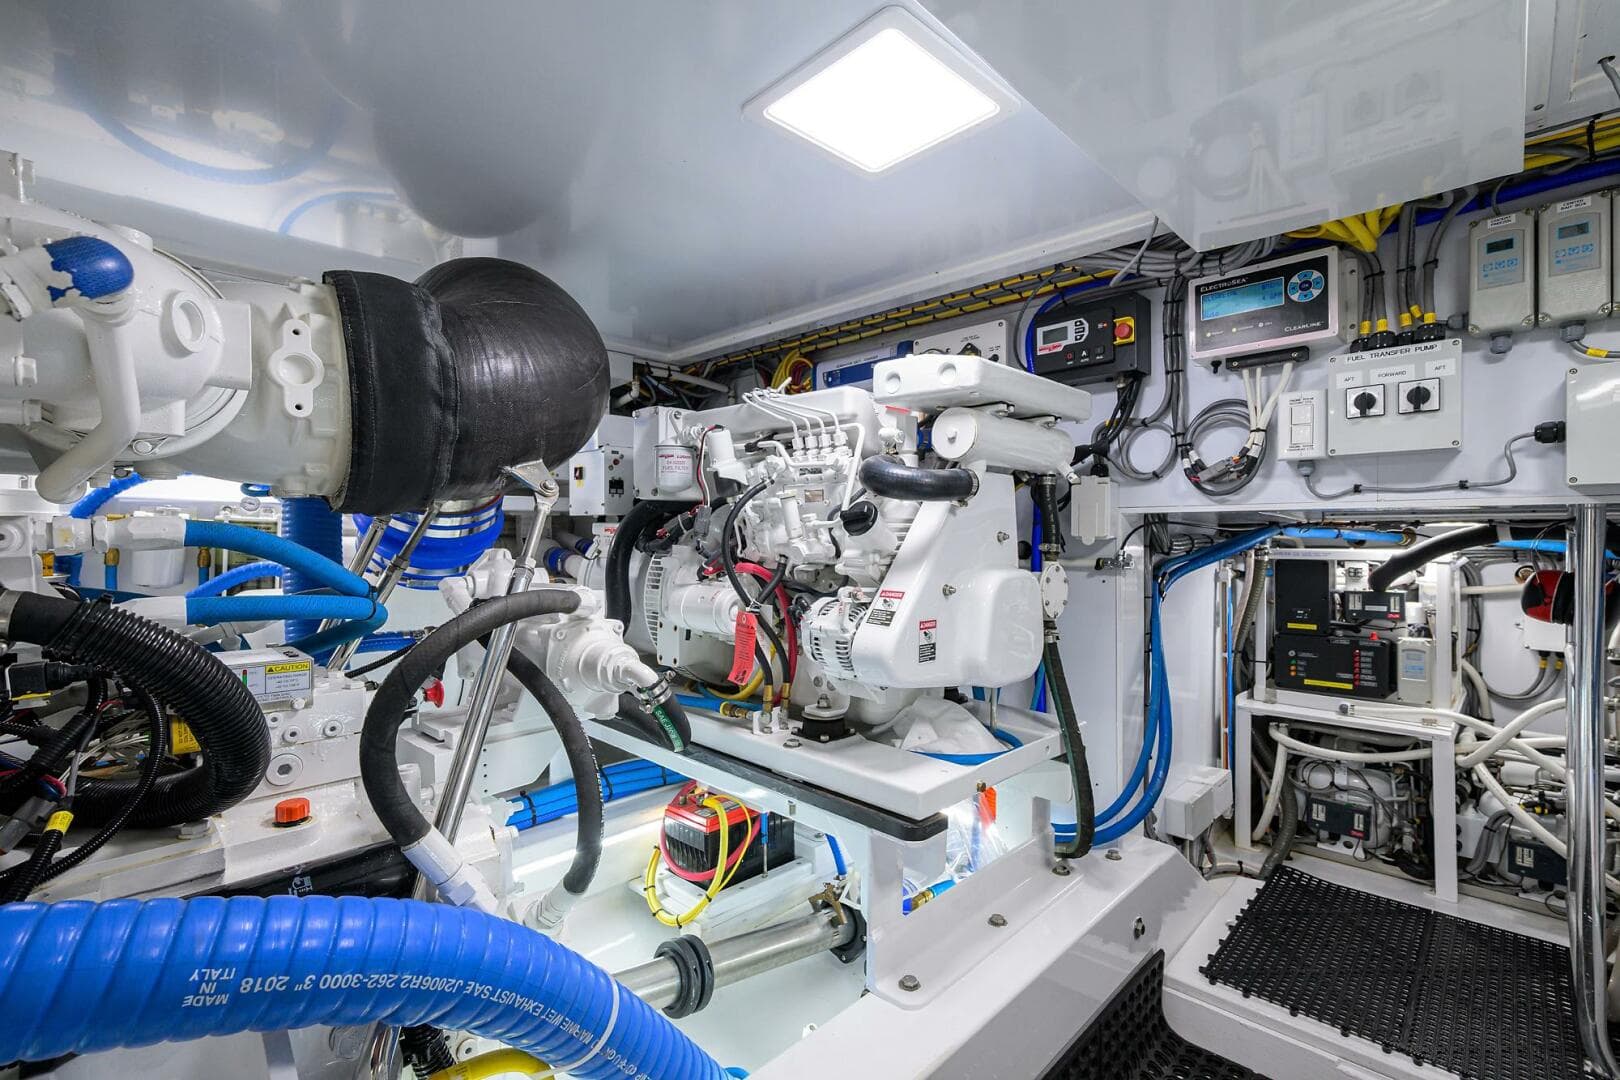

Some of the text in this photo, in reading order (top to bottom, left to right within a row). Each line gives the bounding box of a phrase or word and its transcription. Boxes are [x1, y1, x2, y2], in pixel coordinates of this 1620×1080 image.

[1347, 344, 1438, 362] FUEL TRANSFER PUMP
[275, 663, 308, 672] CAUTION
[189, 967, 236, 981] ITALY
[294, 974, 316, 991] 3"
[319, 973, 399, 990] 262-3000
[199, 982, 217, 994] IN
[239, 975, 290, 993] 2018
[400, 975, 463, 993] J2006R2
[463, 981, 492, 999] SAE
[182, 993, 229, 1008] MADE
[490, 988, 544, 1016] EXHAUST
[540, 1007, 562, 1026] WET
